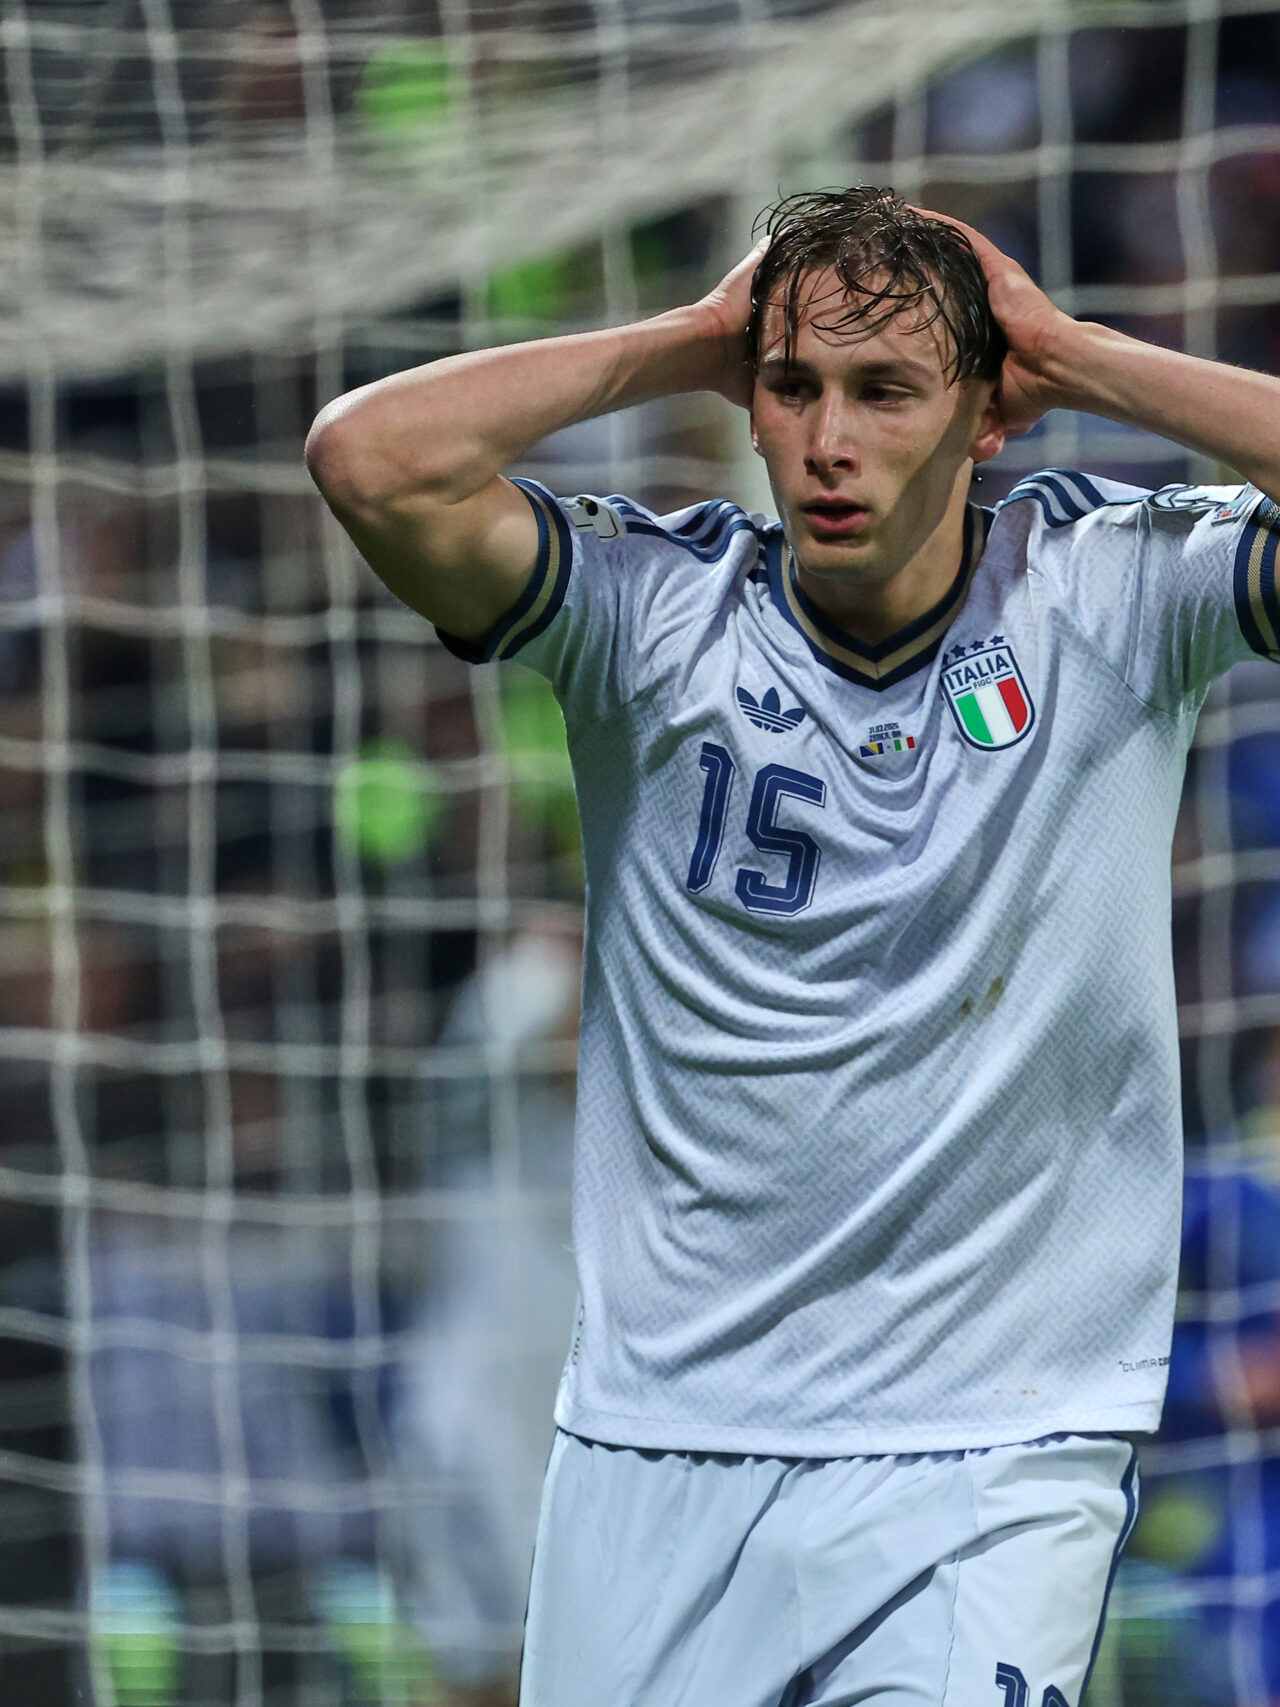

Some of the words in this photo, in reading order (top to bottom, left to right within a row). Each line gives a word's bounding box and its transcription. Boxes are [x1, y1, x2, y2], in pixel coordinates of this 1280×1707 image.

[945, 655, 1010, 690] ITALIA
[973, 677, 992, 689] FIGC
[686, 741, 827, 917] 15
